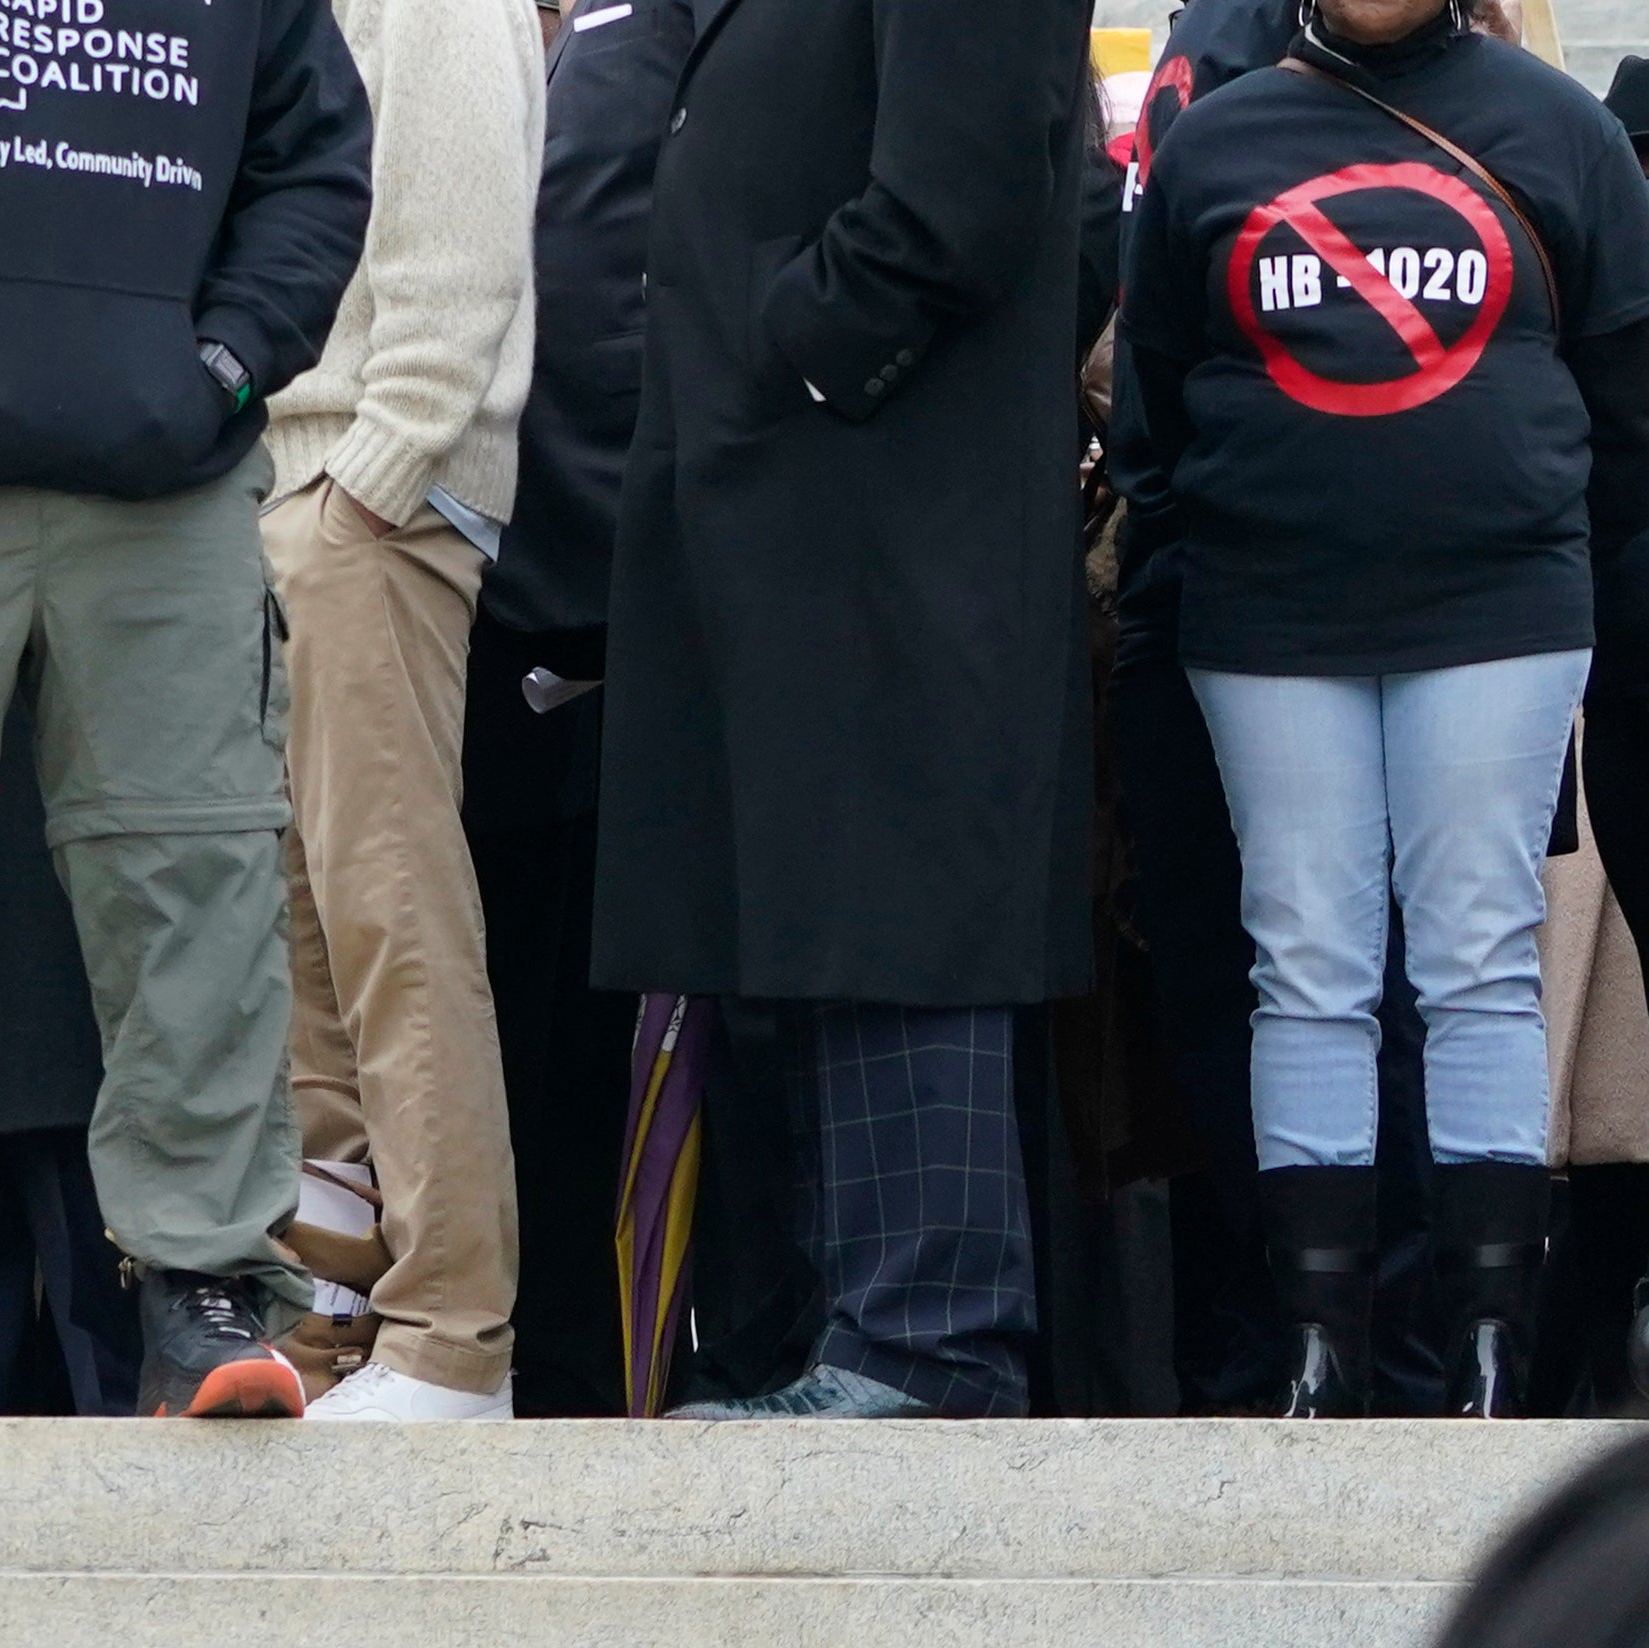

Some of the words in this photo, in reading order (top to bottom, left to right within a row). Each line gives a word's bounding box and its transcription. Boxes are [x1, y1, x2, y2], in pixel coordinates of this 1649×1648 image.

[14, 135, 53, 171] Led,
[54, 141, 154, 189] Community
[1258, 254, 1322, 311] HB
